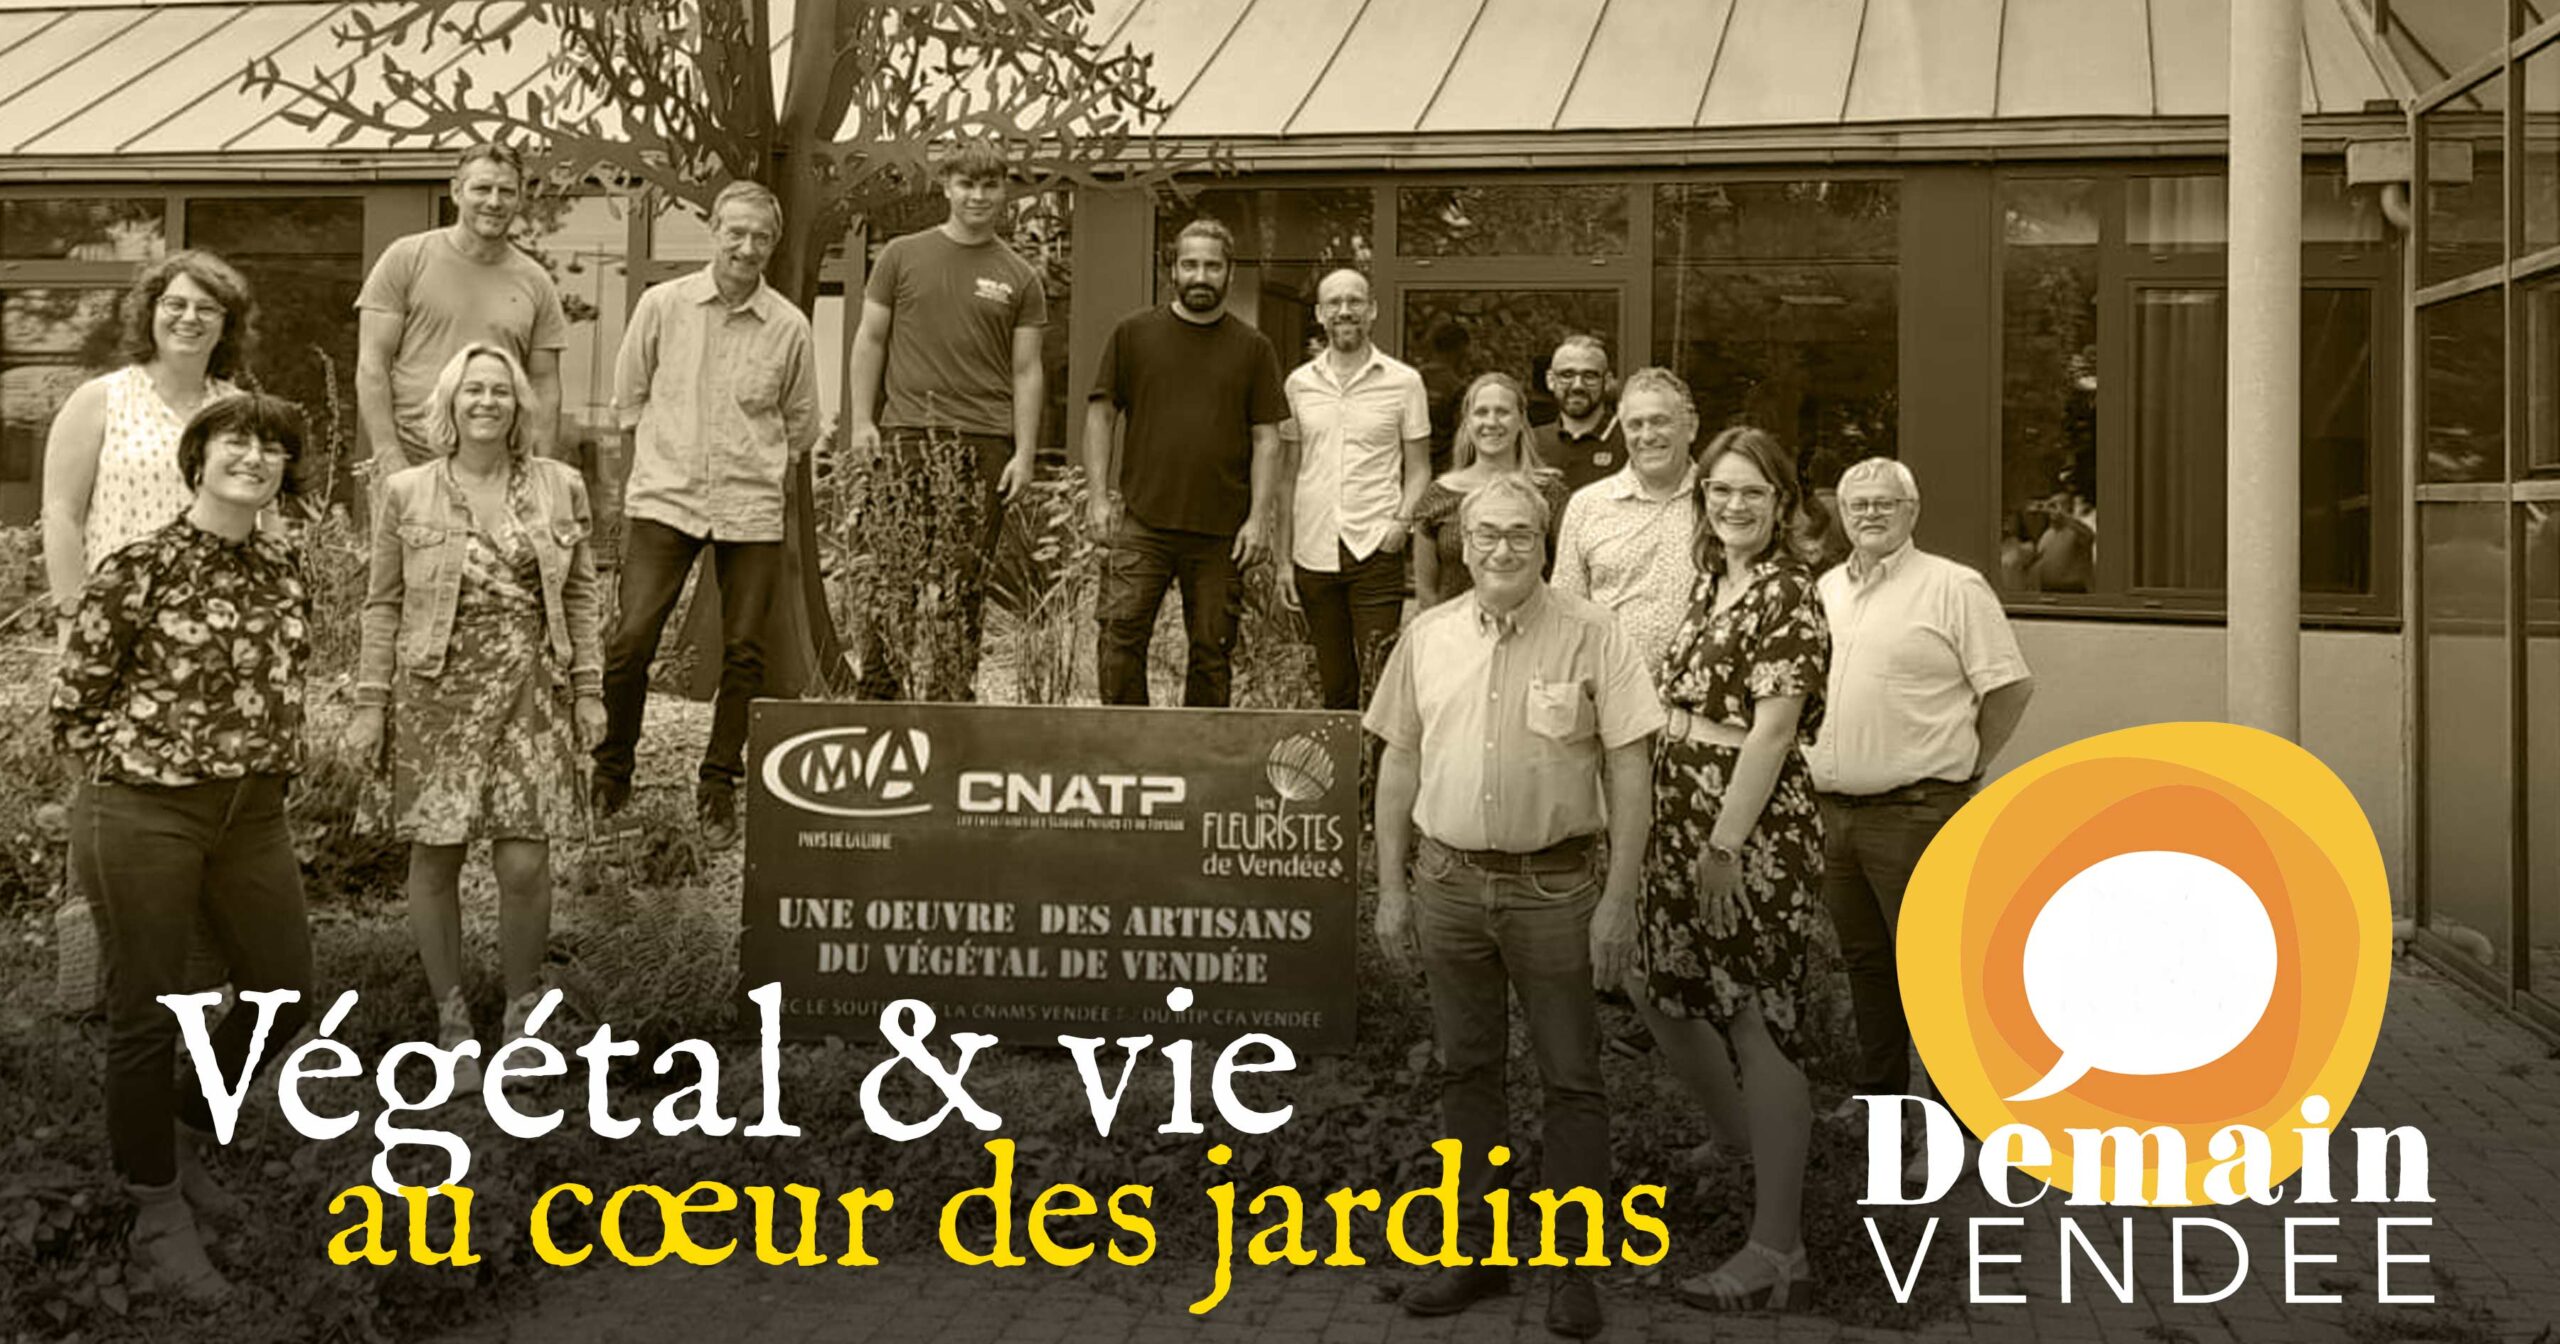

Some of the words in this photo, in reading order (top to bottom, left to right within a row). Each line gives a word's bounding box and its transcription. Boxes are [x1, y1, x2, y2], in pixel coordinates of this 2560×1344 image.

[958, 772, 1186, 816] CNATP
[1203, 811, 1344, 851] FLEURISTES
[1203, 852, 1231, 876] de
[1238, 852, 1327, 877] Vendée
[779, 898, 853, 929] UNE
[866, 899, 1015, 932] OEUVRE
[1040, 904, 1111, 935] DES
[1123, 906, 1313, 940] ARTISANS
[818, 942, 869, 974] DU
[884, 937, 1048, 977] VÉGÉTAL
[1059, 949, 1108, 979] DE
[1121, 945, 1268, 983] VENDÉE
[806, 999, 825, 1016] LE
[944, 1002, 967, 1019] LA
[1212, 1009, 1247, 1026] CFA
